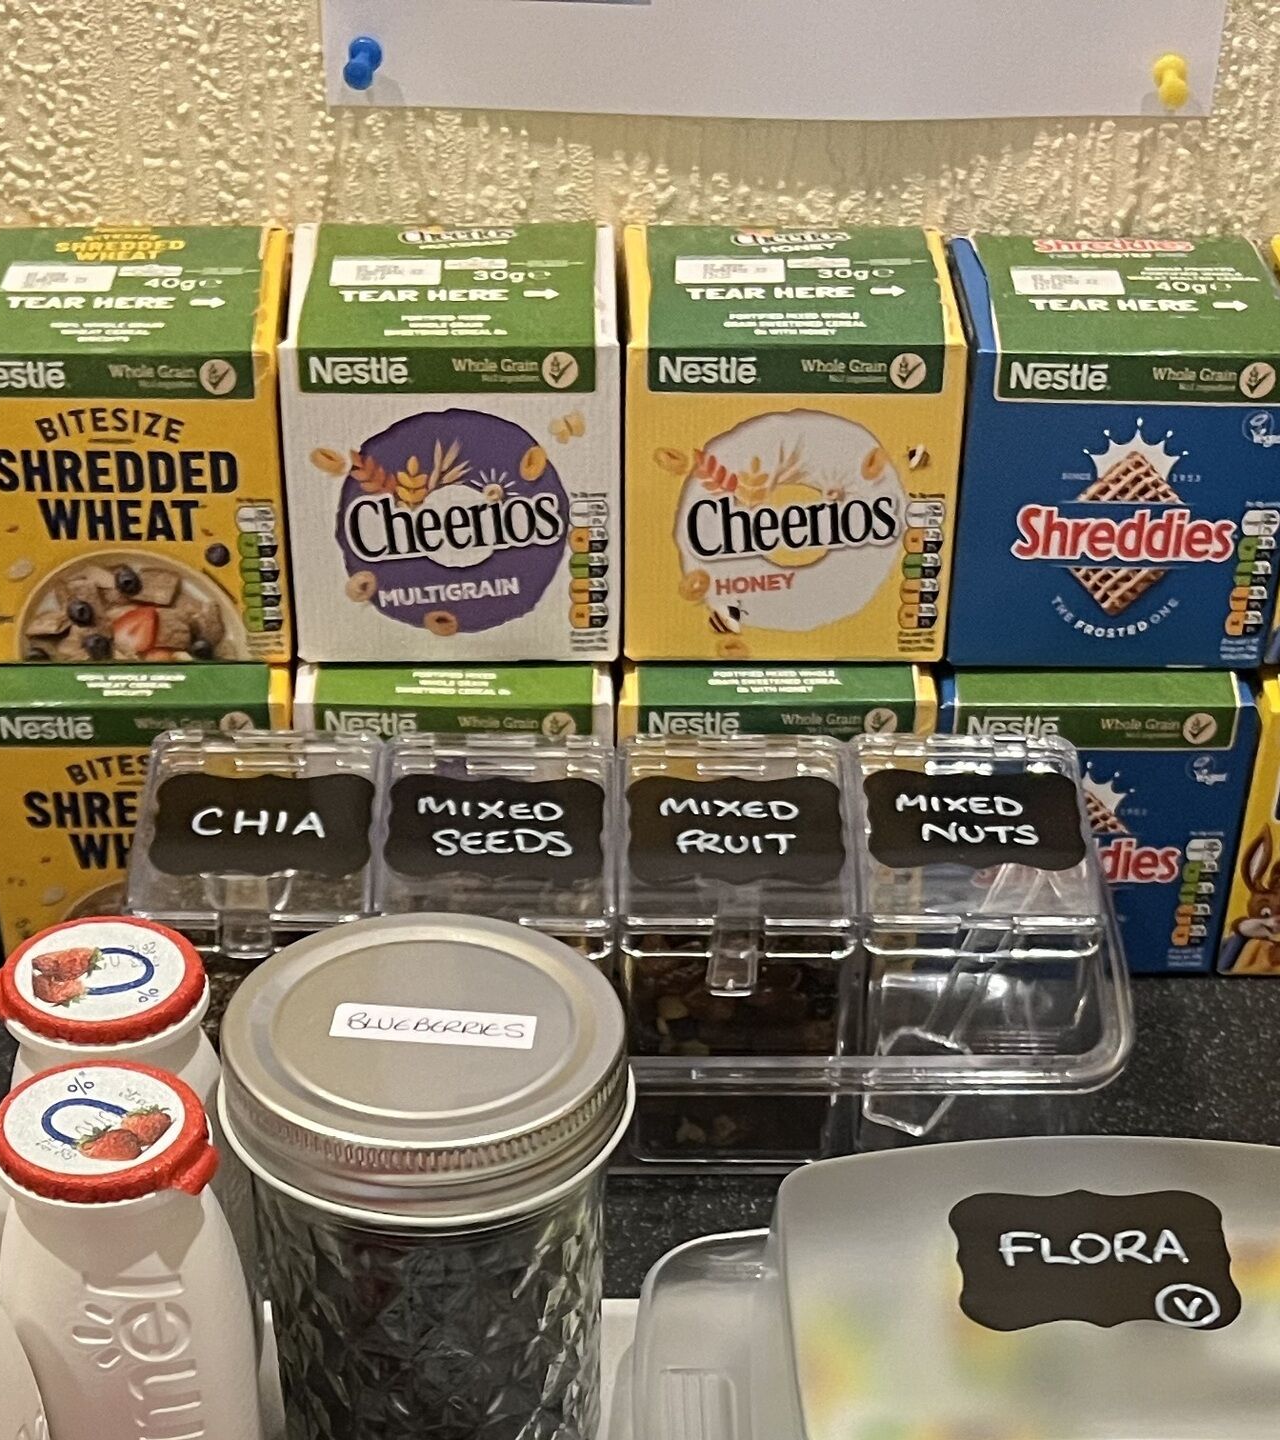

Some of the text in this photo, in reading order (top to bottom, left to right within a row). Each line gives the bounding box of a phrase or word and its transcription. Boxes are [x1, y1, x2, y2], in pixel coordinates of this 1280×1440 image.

[473, 270, 526, 283] 30g
[817, 268, 869, 281] 30g
[6, 296, 176, 309] TEAR HERE
[339, 289, 510, 302] TEAR HERE
[686, 286, 855, 300] TEAR HERE
[1029, 299, 1199, 312] TEAR HERE
[801, 359, 887, 373] Whole Grain
[35, 408, 185, 443] BITESIZE
[37, 499, 199, 541] WHEAT
[349, 495, 560, 558] Cheerios
[687, 496, 897, 557] Cheerios
[1011, 504, 1237, 563] Shreddies
[378, 577, 519, 608] MULTIGRAIN
[715, 572, 796, 596] HONEY
[1051, 596, 1180, 638] THE FROSTED ONE
[418, 796, 563, 821] MIXED
[660, 798, 798, 820] MIXED
[896, 794, 1023, 817] MIXED
[192, 808, 326, 838] CHIA
[922, 822, 1040, 845] NUTS
[432, 829, 573, 857] SEEDS
[676, 828, 797, 855] FRUIT
[347, 1012, 525, 1038] BLUEBERRIES
[998, 1229, 1190, 1267] FLORA
